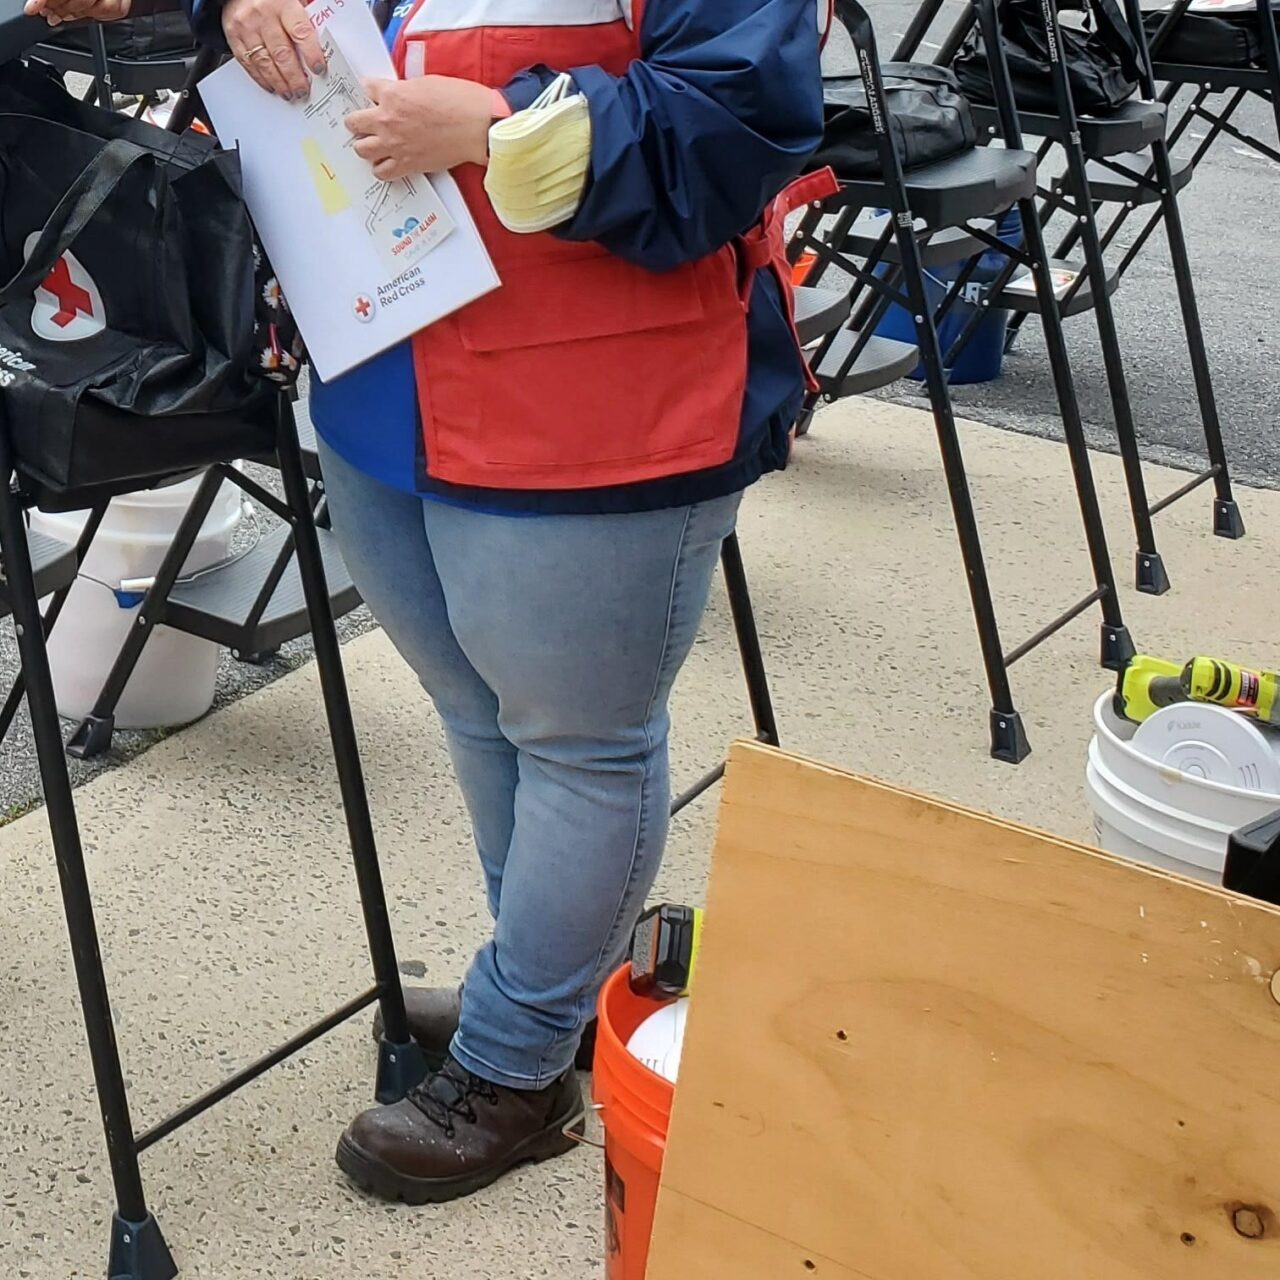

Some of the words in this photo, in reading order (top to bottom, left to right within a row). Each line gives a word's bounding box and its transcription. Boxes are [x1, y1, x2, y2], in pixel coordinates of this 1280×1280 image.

[309, 6, 335, 29] TEAM
[391, 235, 413, 256] SOUND
[376, 266, 422, 297] American
[379, 292, 399, 308] Red
[398, 277, 426, 297] Cross
